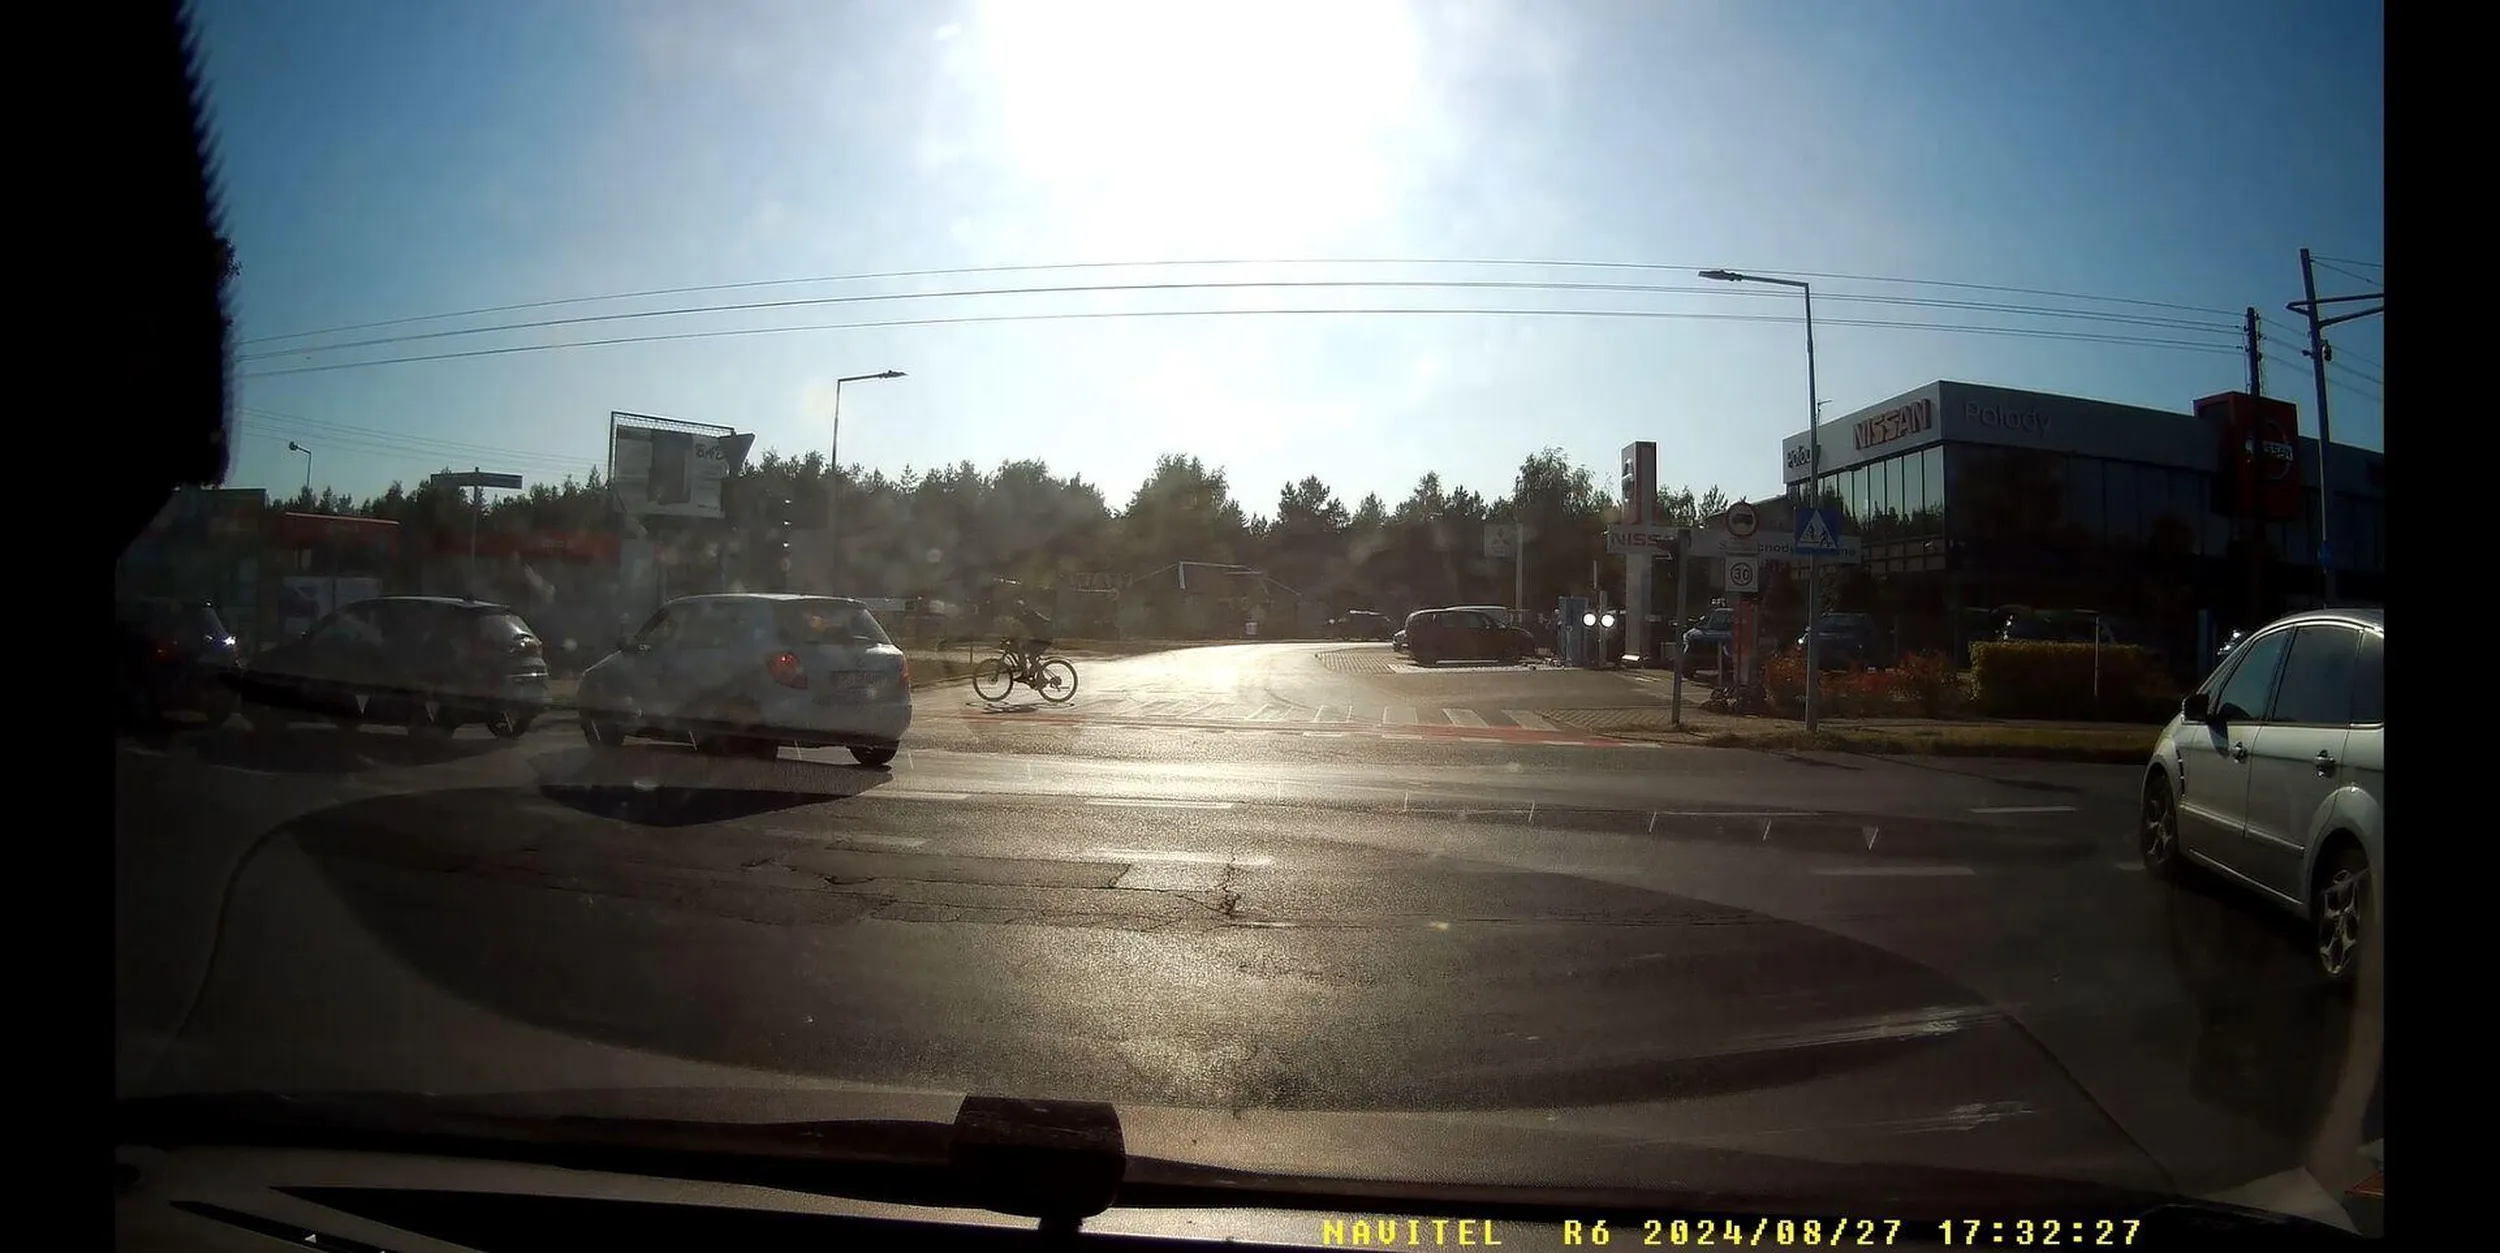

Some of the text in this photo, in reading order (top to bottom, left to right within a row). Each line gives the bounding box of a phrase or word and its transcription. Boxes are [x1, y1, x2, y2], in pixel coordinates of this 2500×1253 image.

[1853, 398, 1931, 450] NISSAN
[1611, 532, 1691, 548] NISS
[1733, 567, 1750, 581] 30
